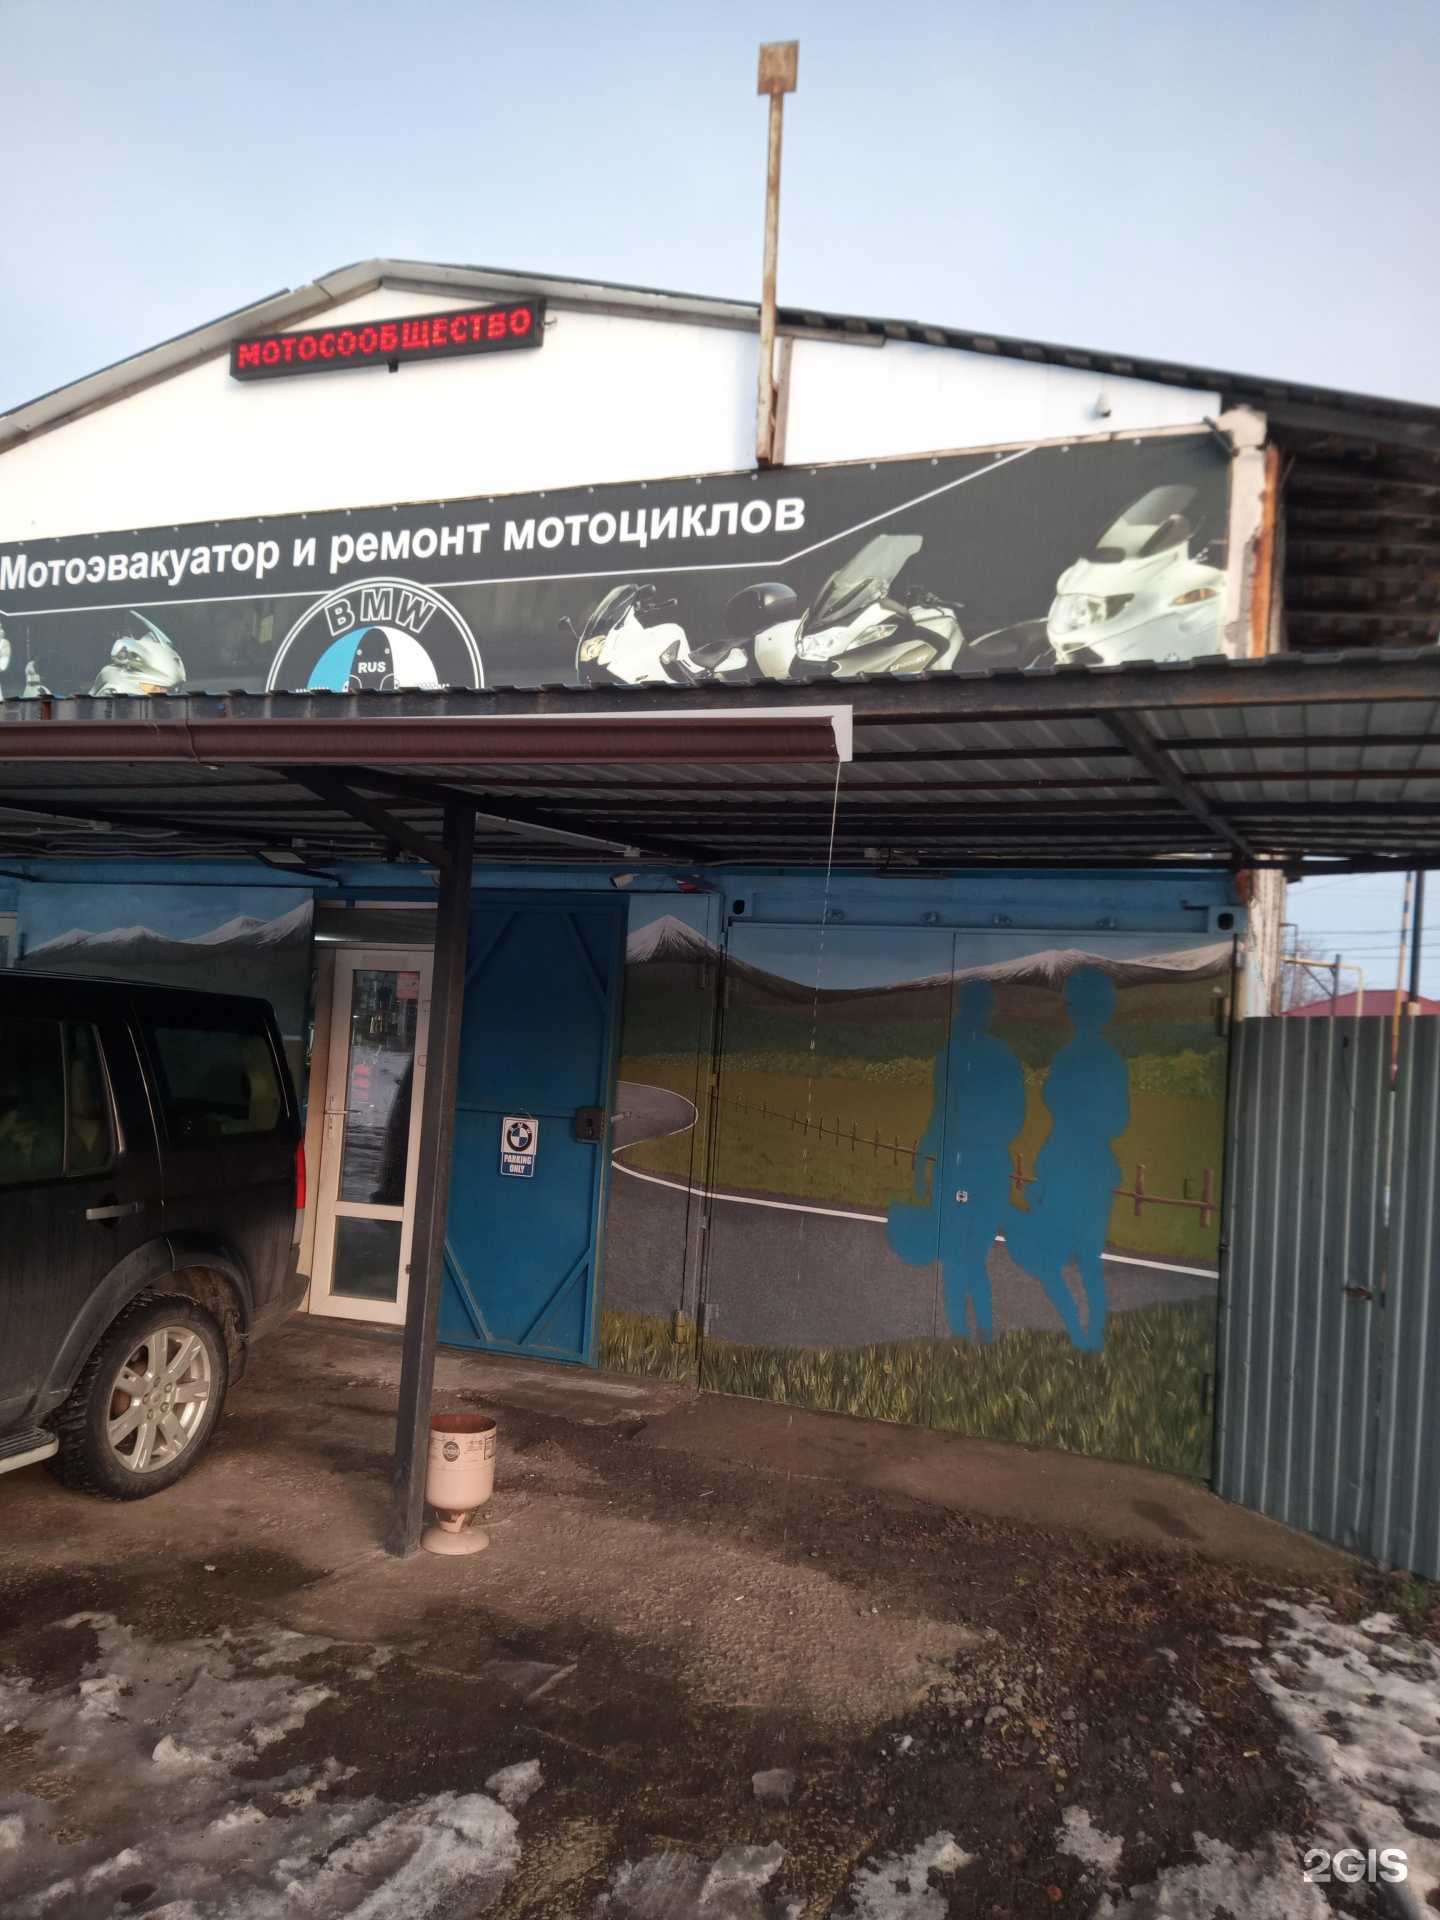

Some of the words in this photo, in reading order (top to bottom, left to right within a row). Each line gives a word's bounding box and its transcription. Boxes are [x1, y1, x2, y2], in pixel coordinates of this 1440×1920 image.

[237, 307, 532, 369] МОТОСООБЩЕСТВО
[0, 539, 280, 591] Мотоэвакуатор
[292, 537, 317, 567] и
[329, 522, 491, 575] ремонт
[503, 497, 806, 551] мотоциклов
[324, 587, 437, 637] BMW
[358, 661, 387, 674] RUS
[503, 1154, 532, 1165] PARKING
[509, 1164, 525, 1174] ONLY
